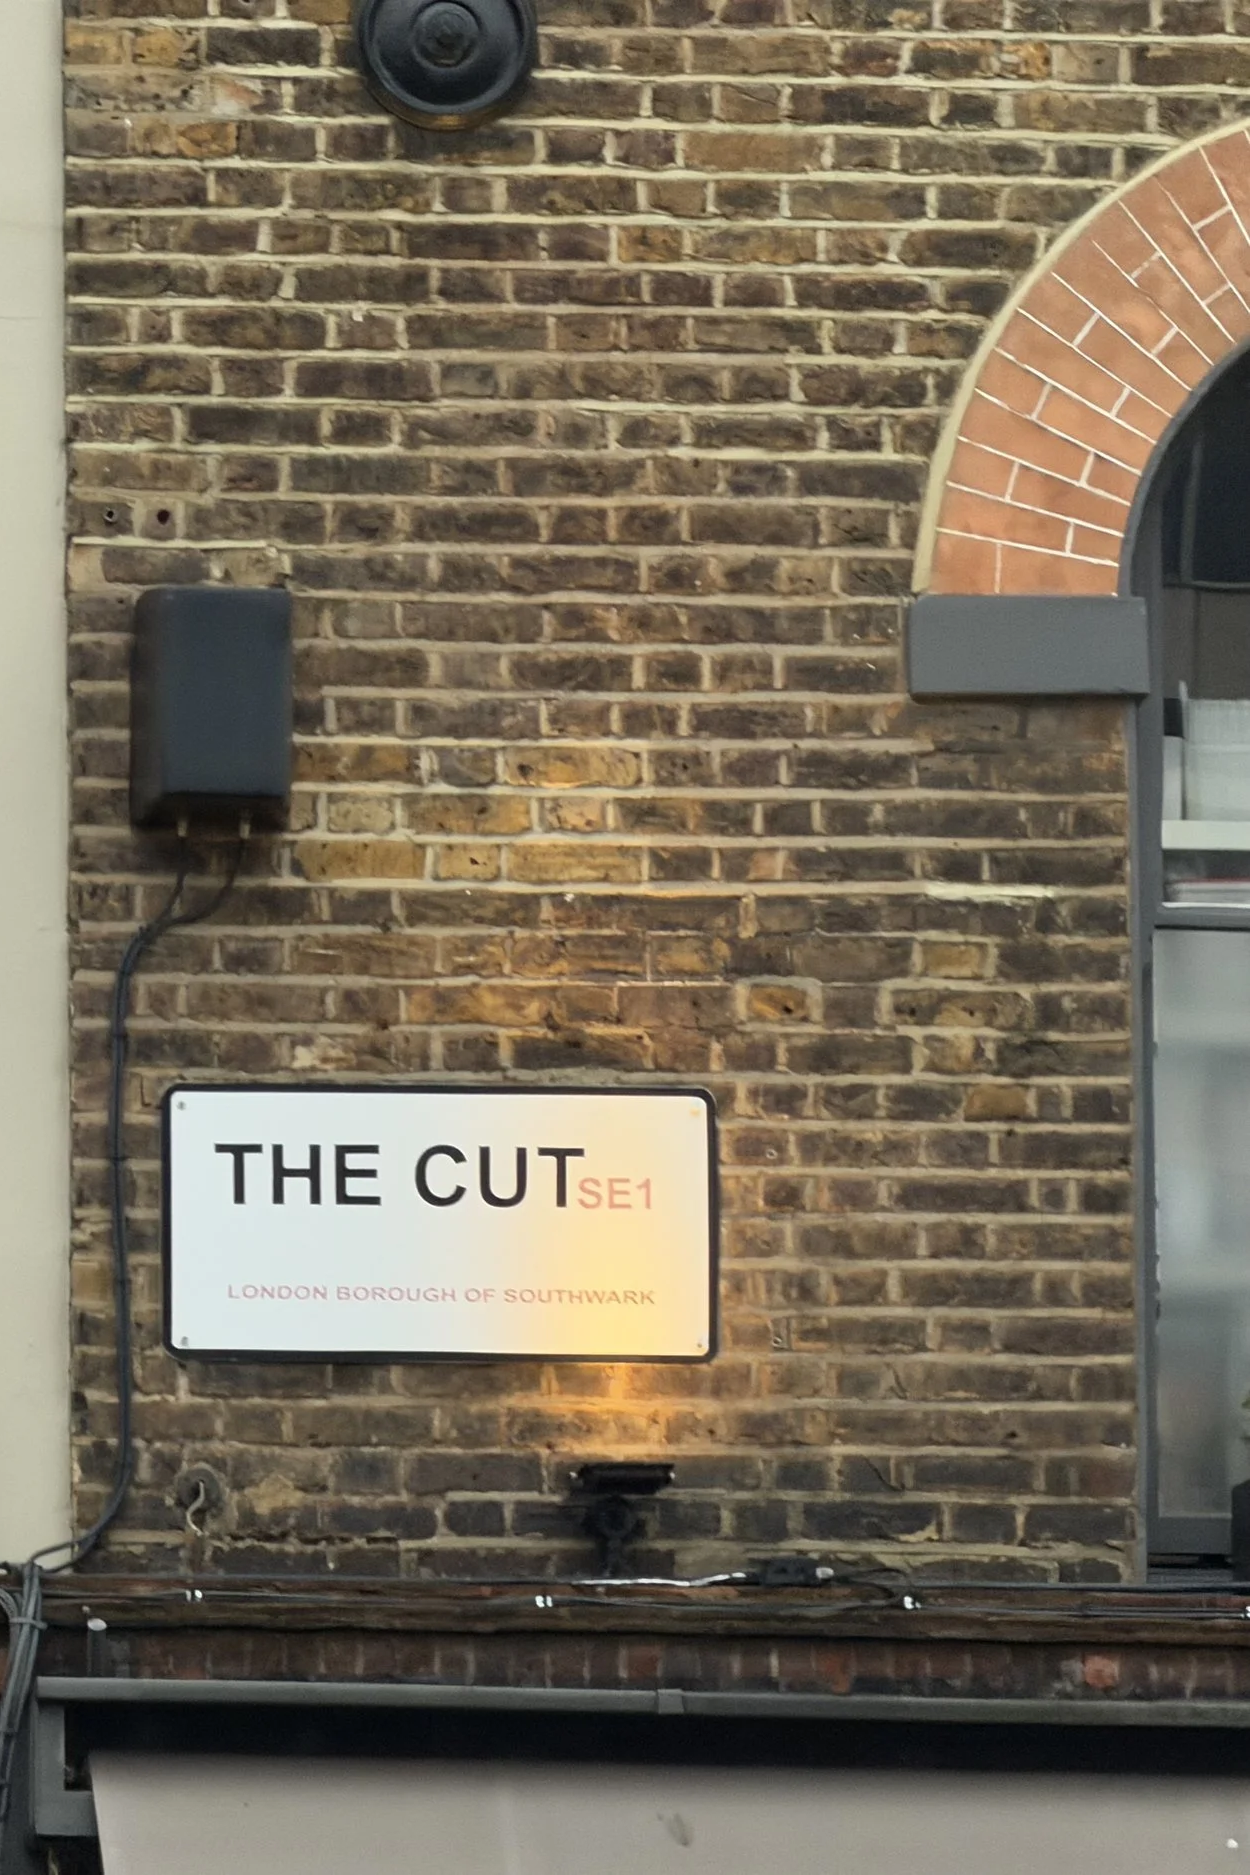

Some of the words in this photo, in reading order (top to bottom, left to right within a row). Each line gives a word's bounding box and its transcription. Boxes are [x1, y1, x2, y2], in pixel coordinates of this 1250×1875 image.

[215, 1143, 381, 1206] THE
[415, 1145, 585, 1208] CUT
[577, 1177, 652, 1210] SE1
[228, 1284, 328, 1301] LONDON
[336, 1286, 457, 1303] BOROUGH
[464, 1288, 496, 1303] OF
[503, 1288, 656, 1305] SOUTHWARK
